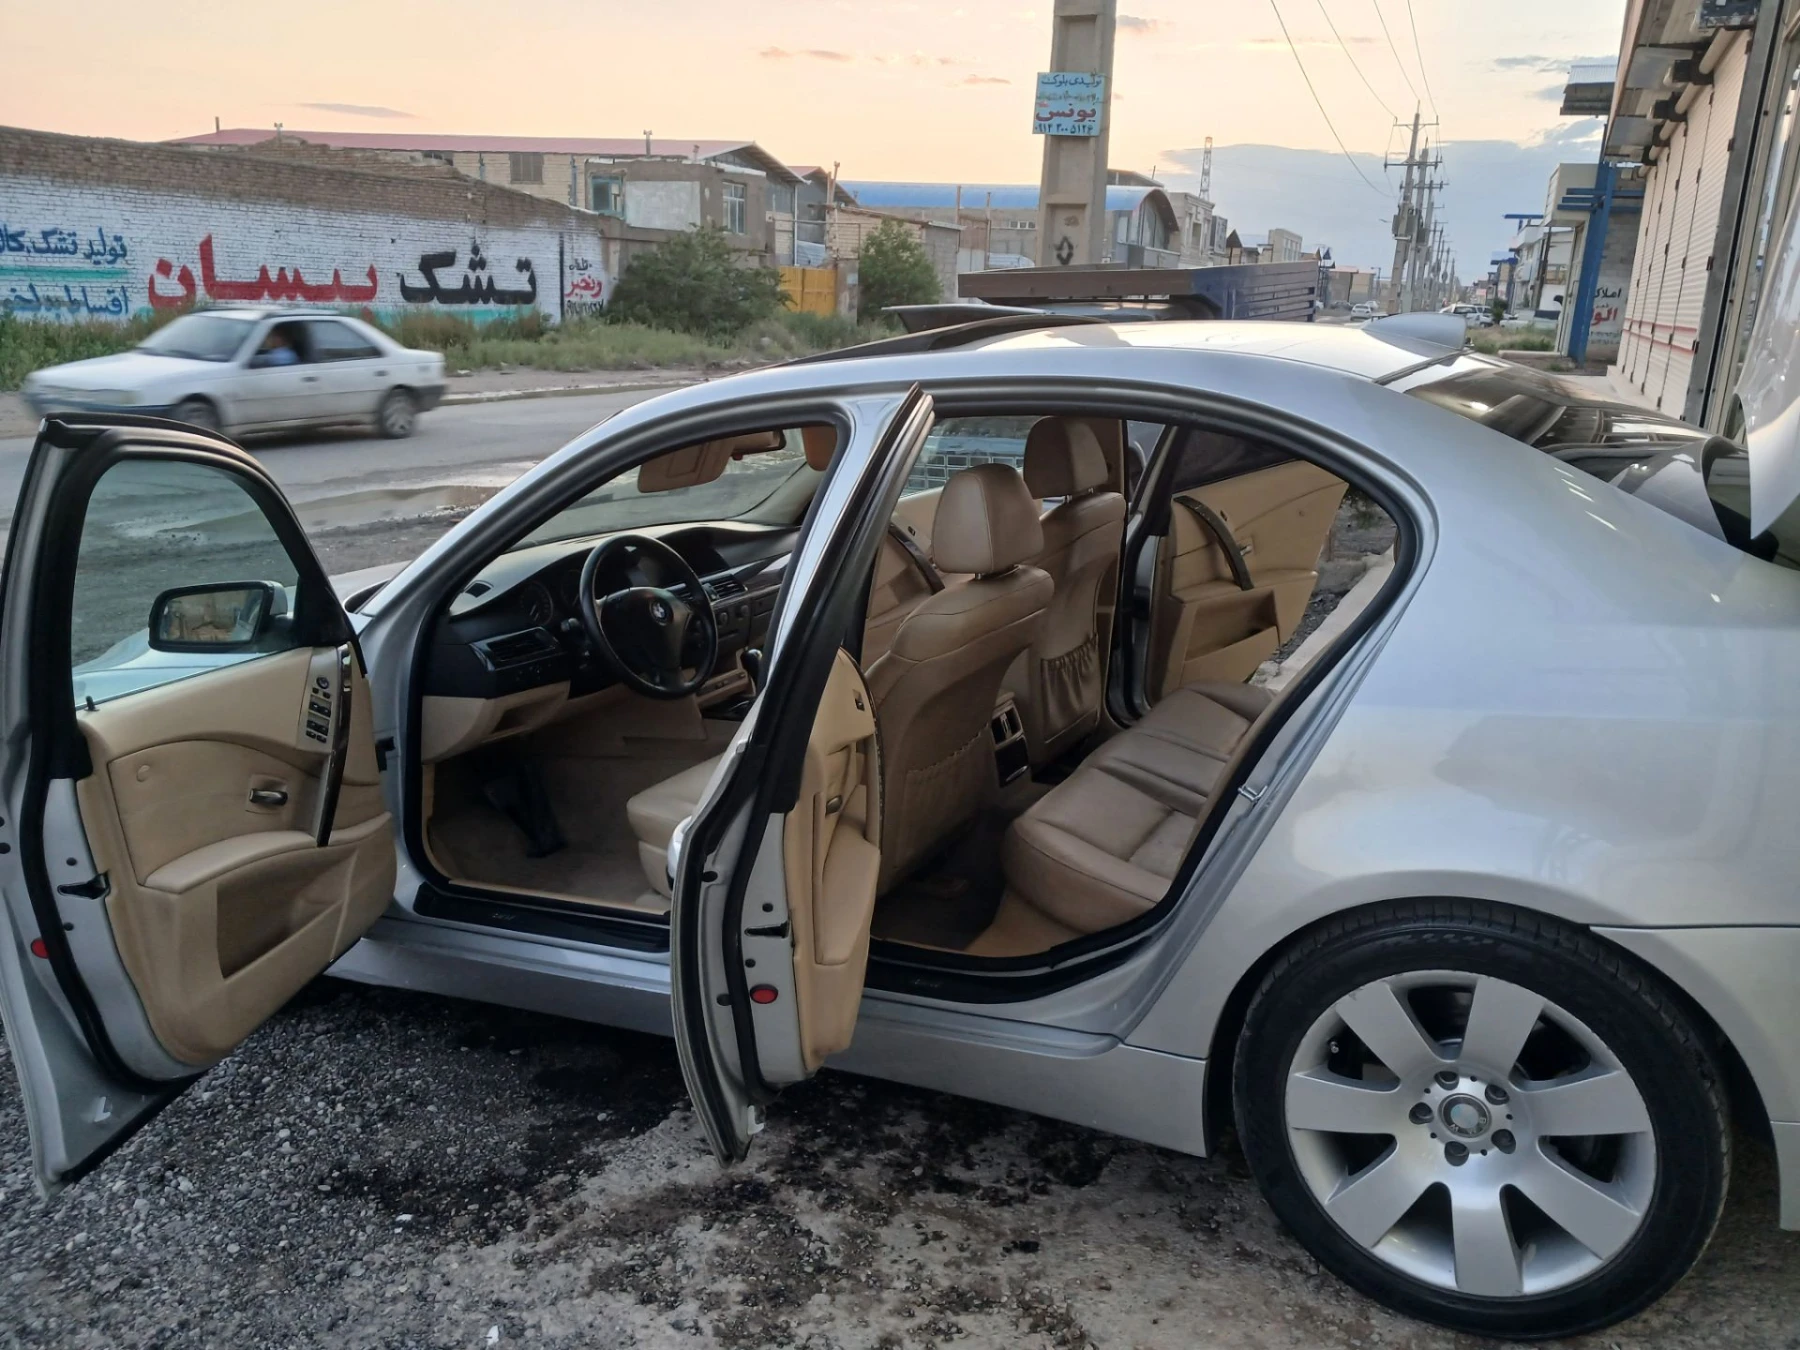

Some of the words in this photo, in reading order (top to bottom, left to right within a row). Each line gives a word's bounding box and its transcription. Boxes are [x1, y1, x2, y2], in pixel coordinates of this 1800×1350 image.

[1035, 103, 1097, 123] یونس
[83, 226, 127, 266] تولید
[400, 243, 537, 304] تشک
